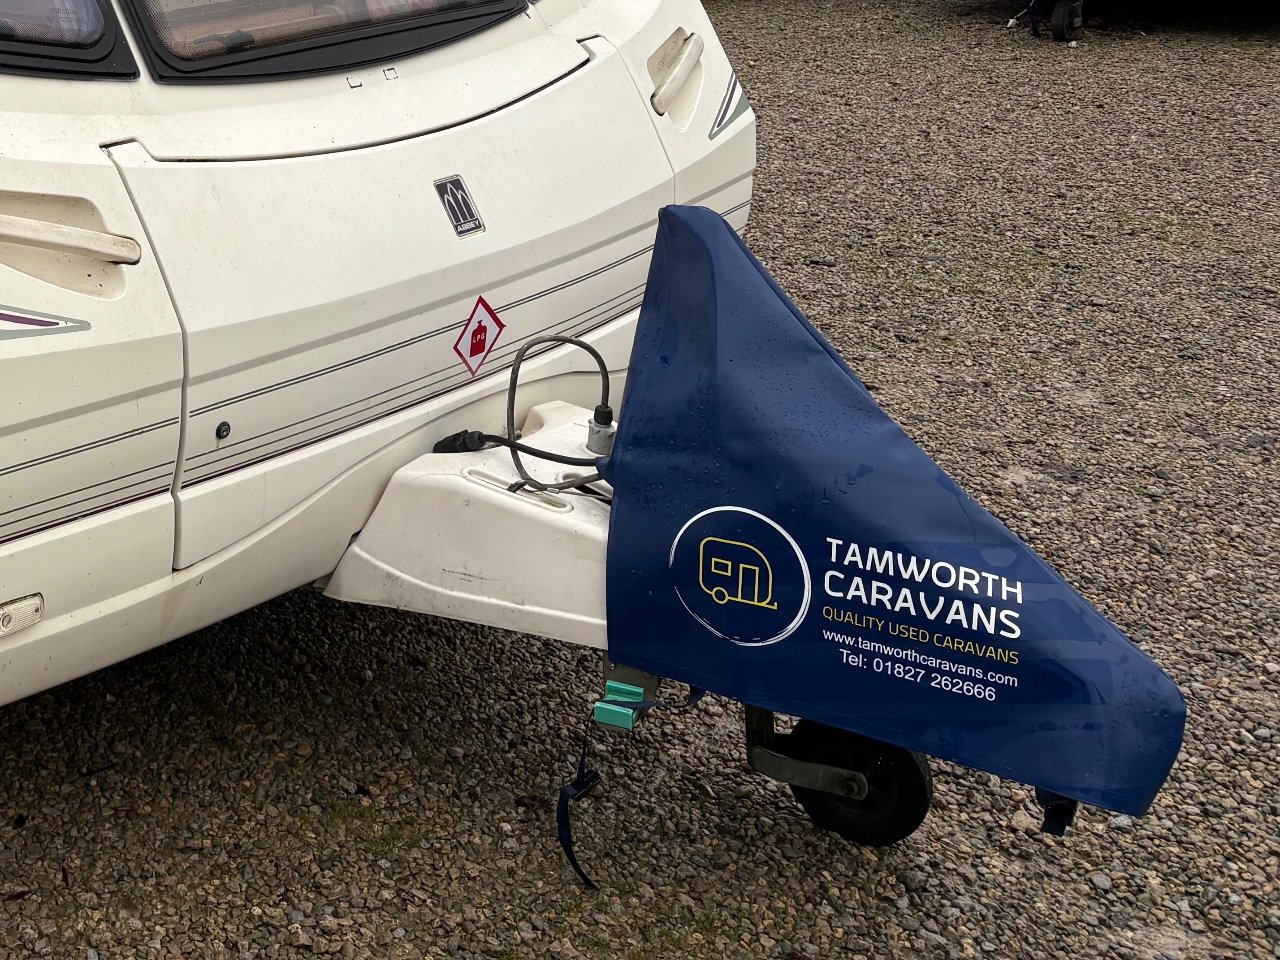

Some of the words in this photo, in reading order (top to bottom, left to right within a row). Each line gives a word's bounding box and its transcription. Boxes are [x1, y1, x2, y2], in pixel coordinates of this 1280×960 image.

[457, 220, 480, 232] ABBEY
[473, 332, 486, 343] LPG
[826, 537, 1023, 604] TAMWORTH
[824, 570, 1022, 639] CARAVANS
[822, 606, 885, 632] QUALITY
[888, 622, 930, 643] USED
[933, 633, 1020, 664] CARAVANS
[822, 629, 1019, 687] www.tamworthcaravans.com
[839, 648, 868, 670] Tel:
[872, 657, 926, 683] 01827
[930, 673, 997, 702] 262666
